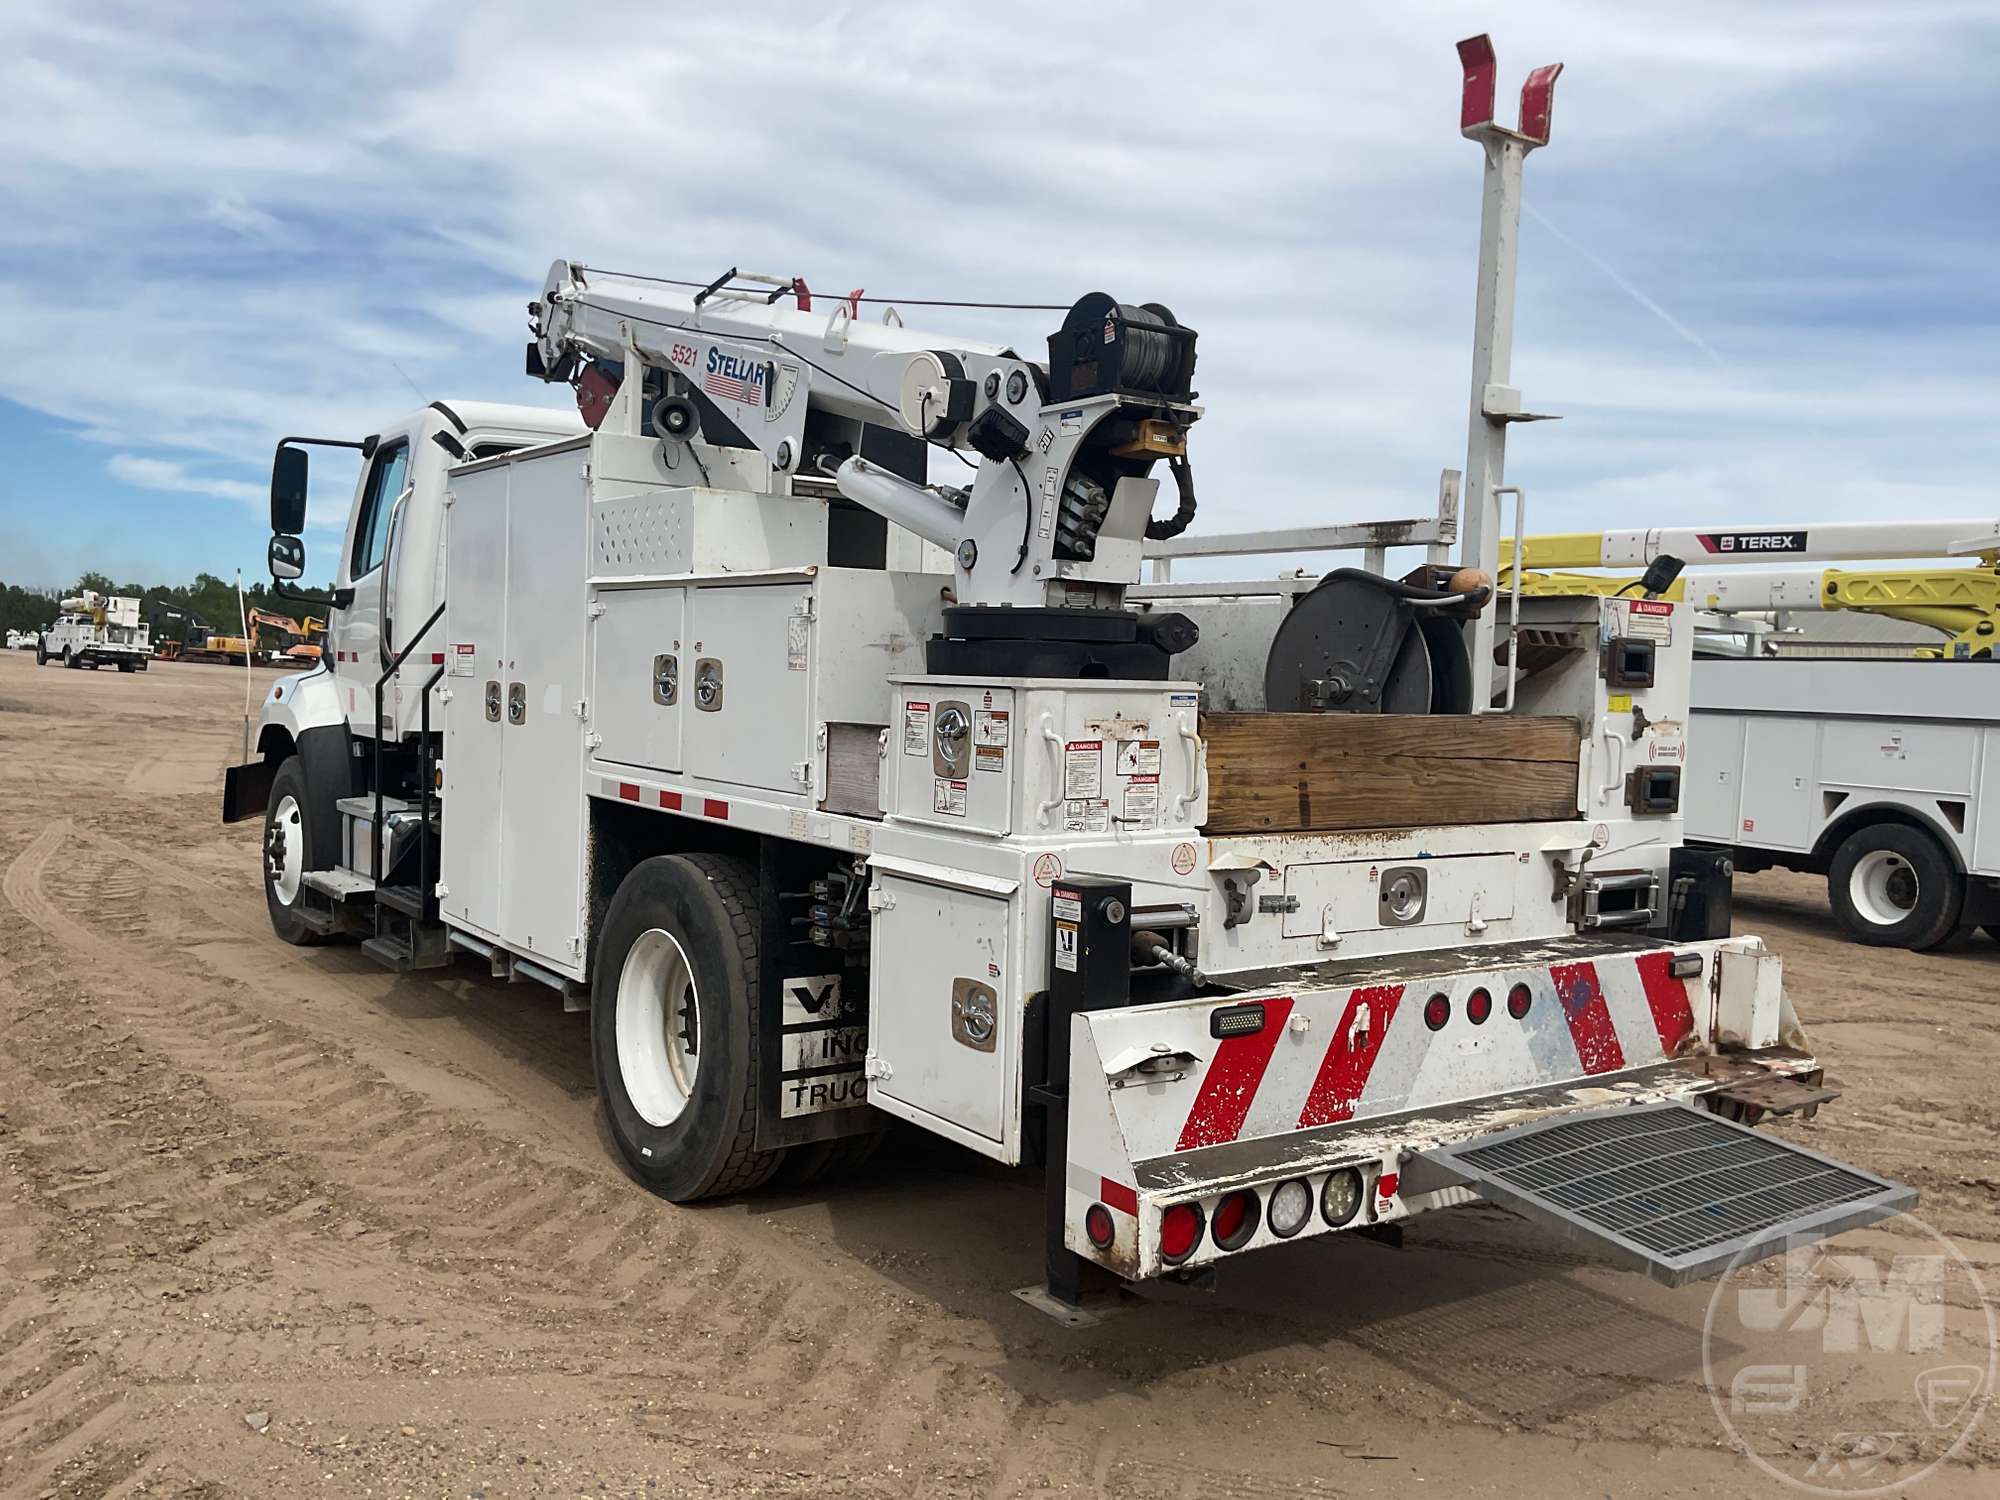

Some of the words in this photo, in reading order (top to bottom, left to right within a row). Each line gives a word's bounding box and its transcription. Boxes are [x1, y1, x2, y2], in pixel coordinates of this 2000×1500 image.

[671, 343, 698, 368] 5521
[706, 346, 766, 386] STELLAR
[1739, 535, 1794, 549] TEREX
[1075, 742, 1099, 750] DANGER
